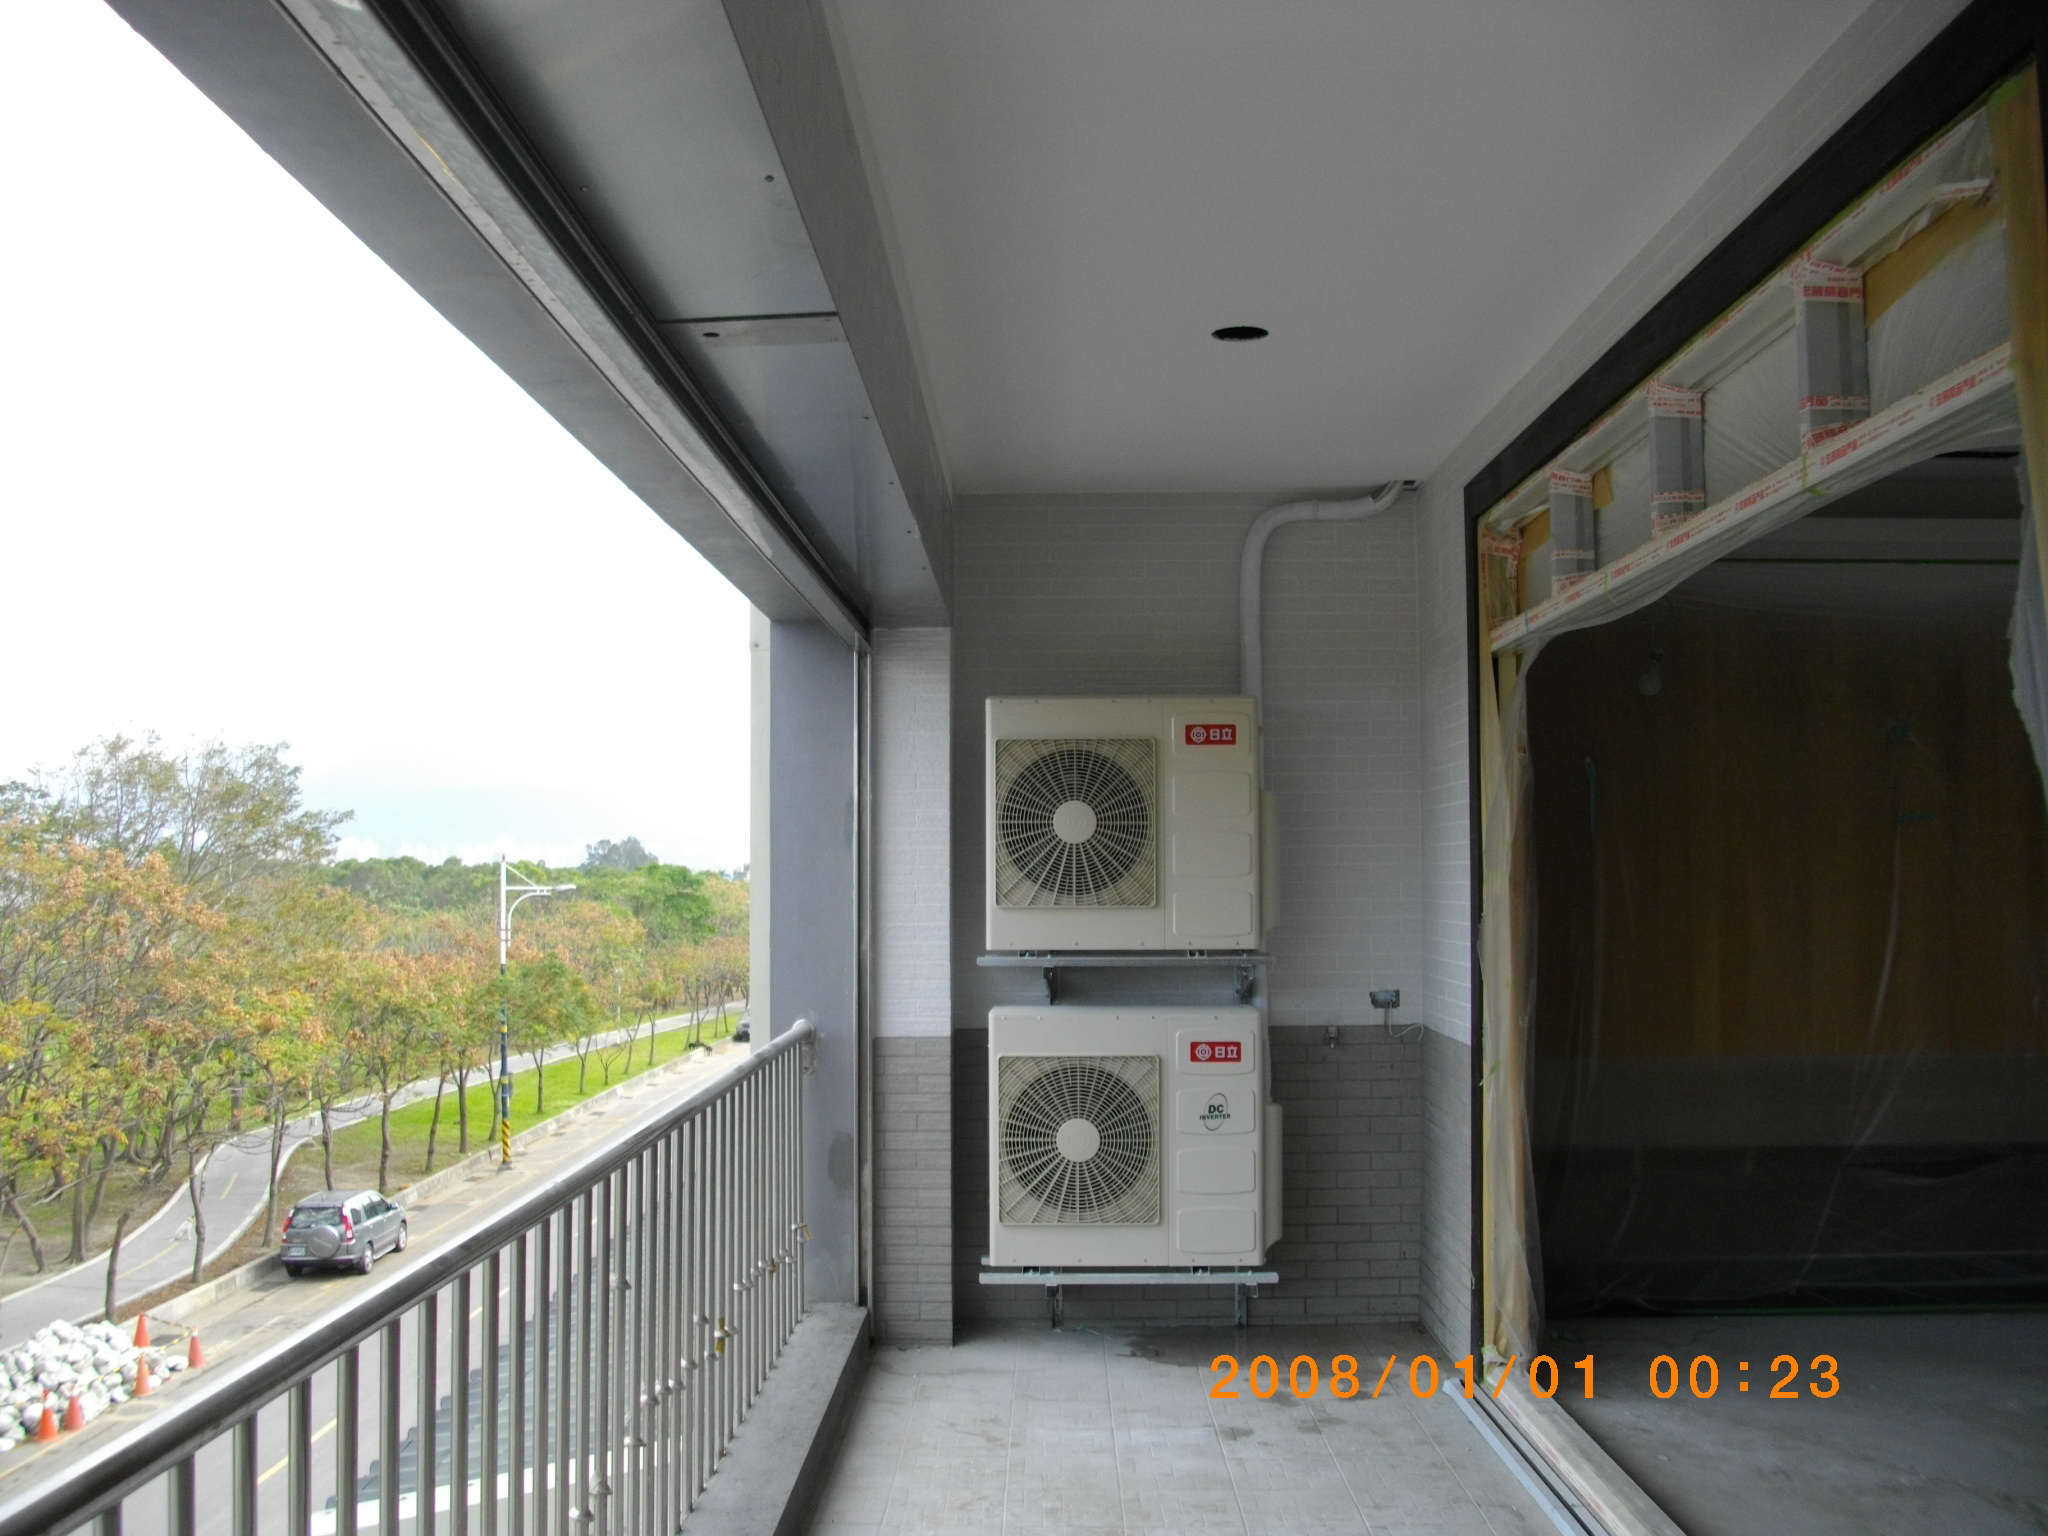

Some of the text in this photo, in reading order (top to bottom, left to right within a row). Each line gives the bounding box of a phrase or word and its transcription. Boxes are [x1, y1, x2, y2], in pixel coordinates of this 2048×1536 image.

[1209, 728, 1233, 741] 日立
[1214, 1045, 1238, 1058] 日立
[1208, 1104, 1224, 1113] DC
